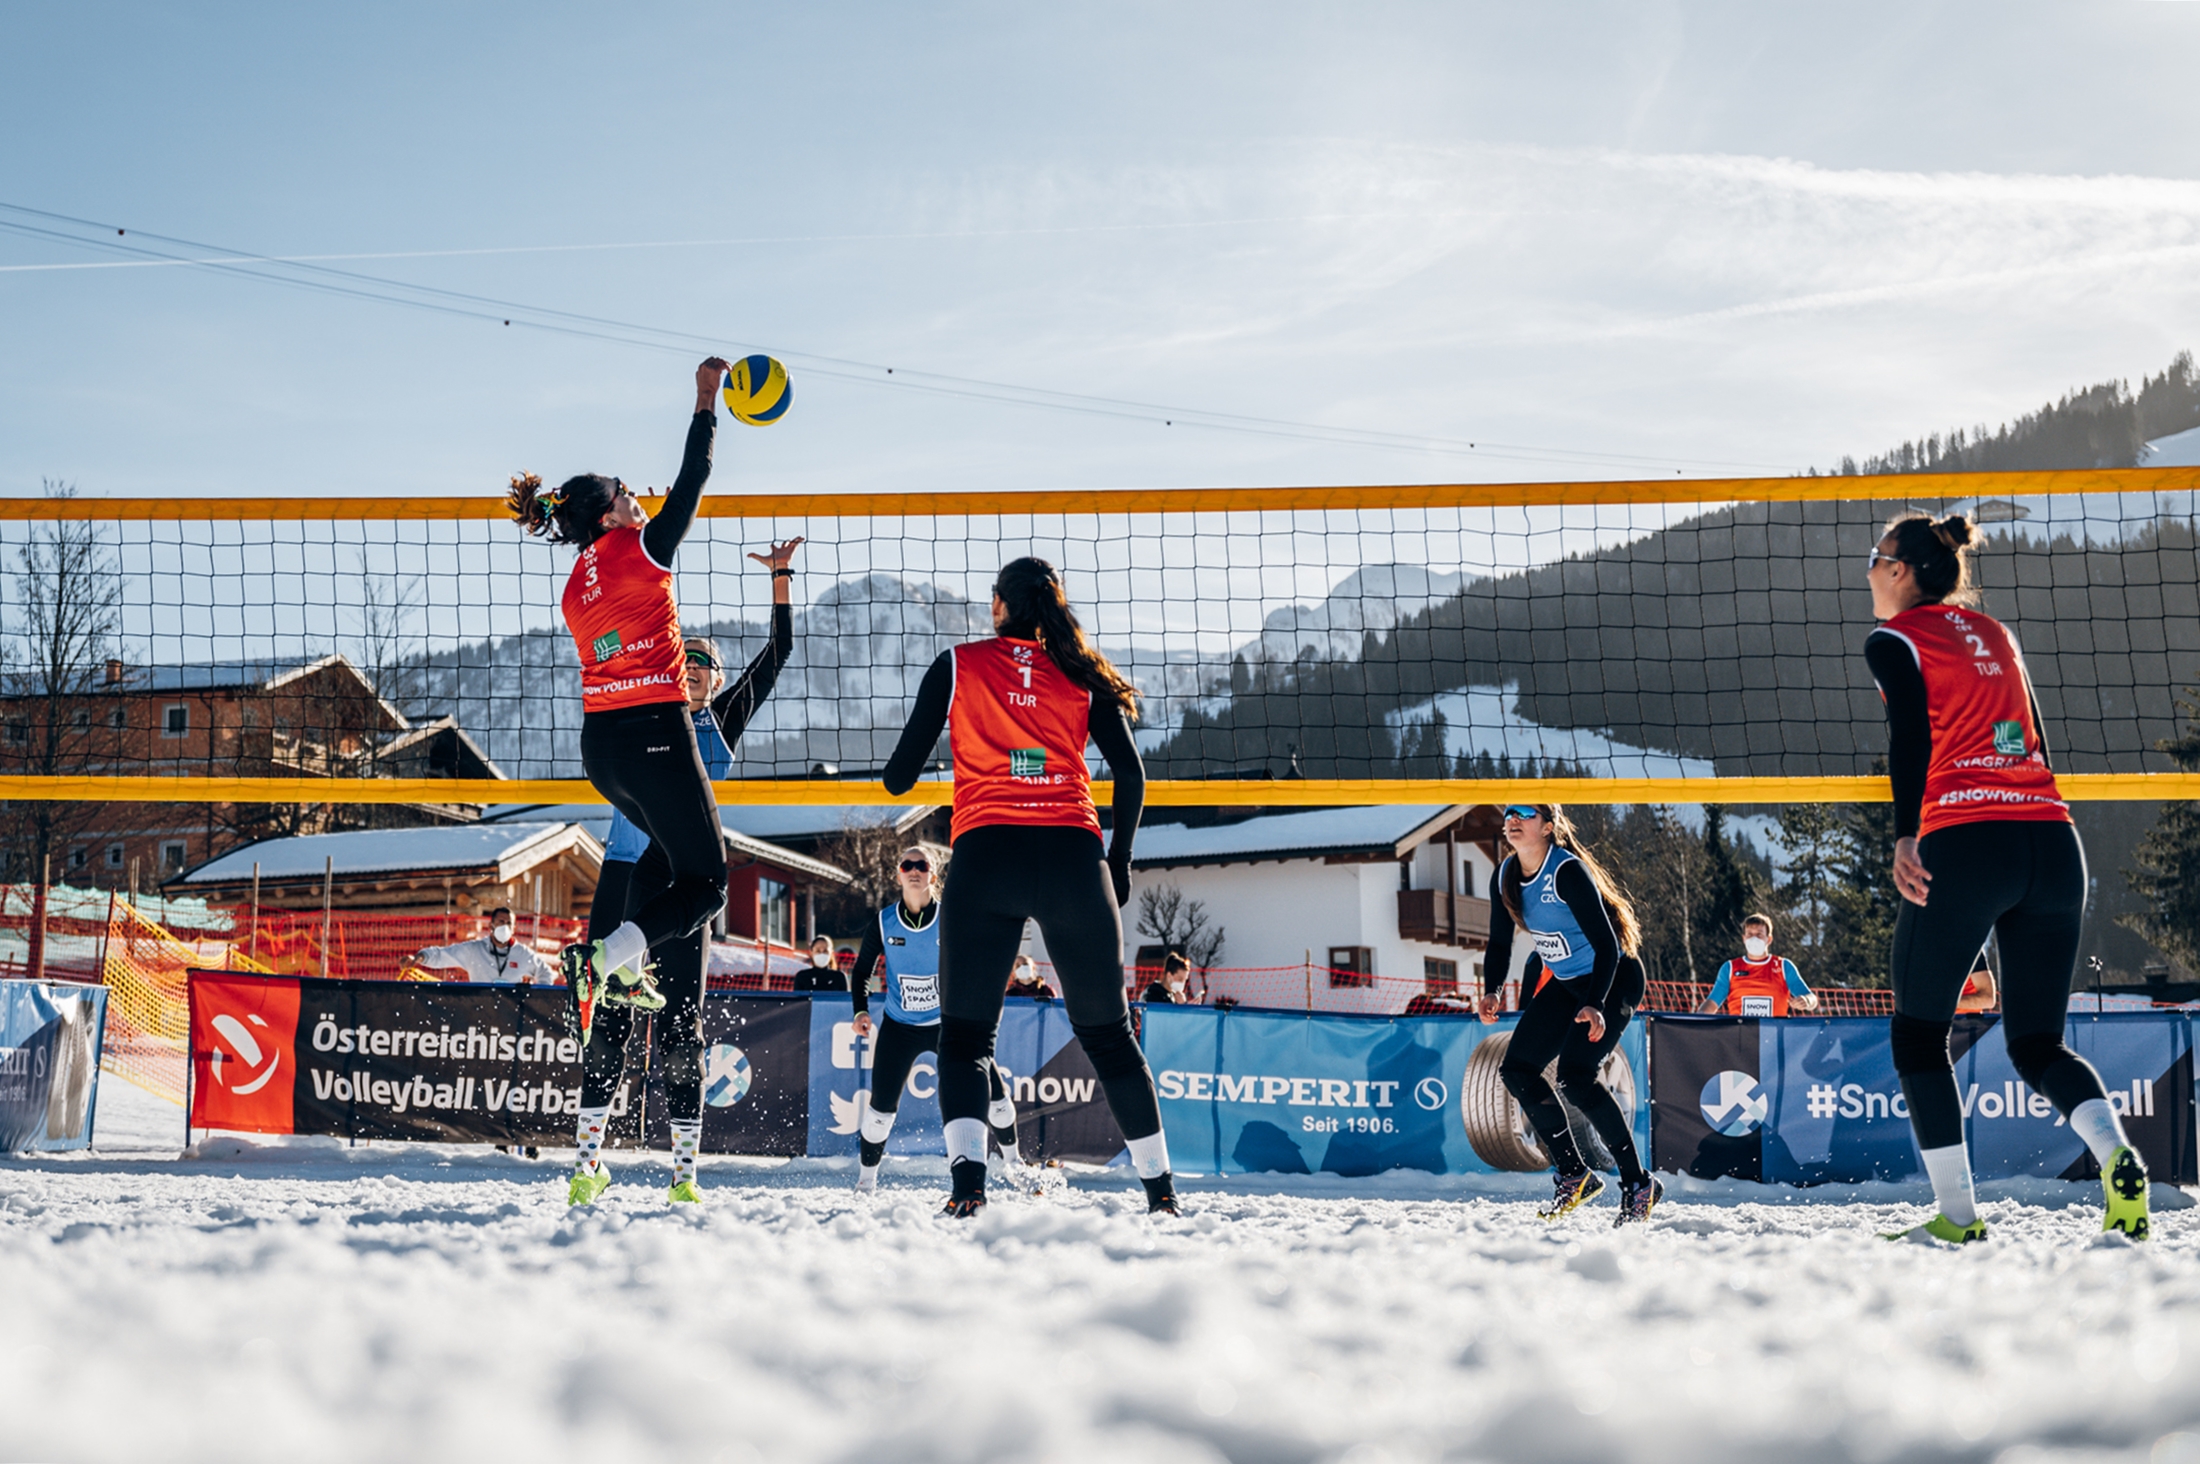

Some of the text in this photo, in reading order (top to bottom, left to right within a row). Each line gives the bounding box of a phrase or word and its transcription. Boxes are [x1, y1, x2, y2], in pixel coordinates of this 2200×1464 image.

[585, 565, 598, 587] 3
[581, 586, 603, 605] TUR
[1965, 634, 1991, 657] 2
[1017, 666, 1032, 689] 1
[1973, 661, 2003, 676] TUR
[1007, 691, 1037, 708] TUR
[1541, 873, 1553, 892] 2
[905, 984, 933, 994] SNOW
[907, 994, 937, 1003] SPACE
[310, 1067, 629, 1117] Volleyball Verbad
[1158, 1069, 1400, 1108] SEMPERIT
[1302, 1115, 1400, 1134] Seit 1906.
